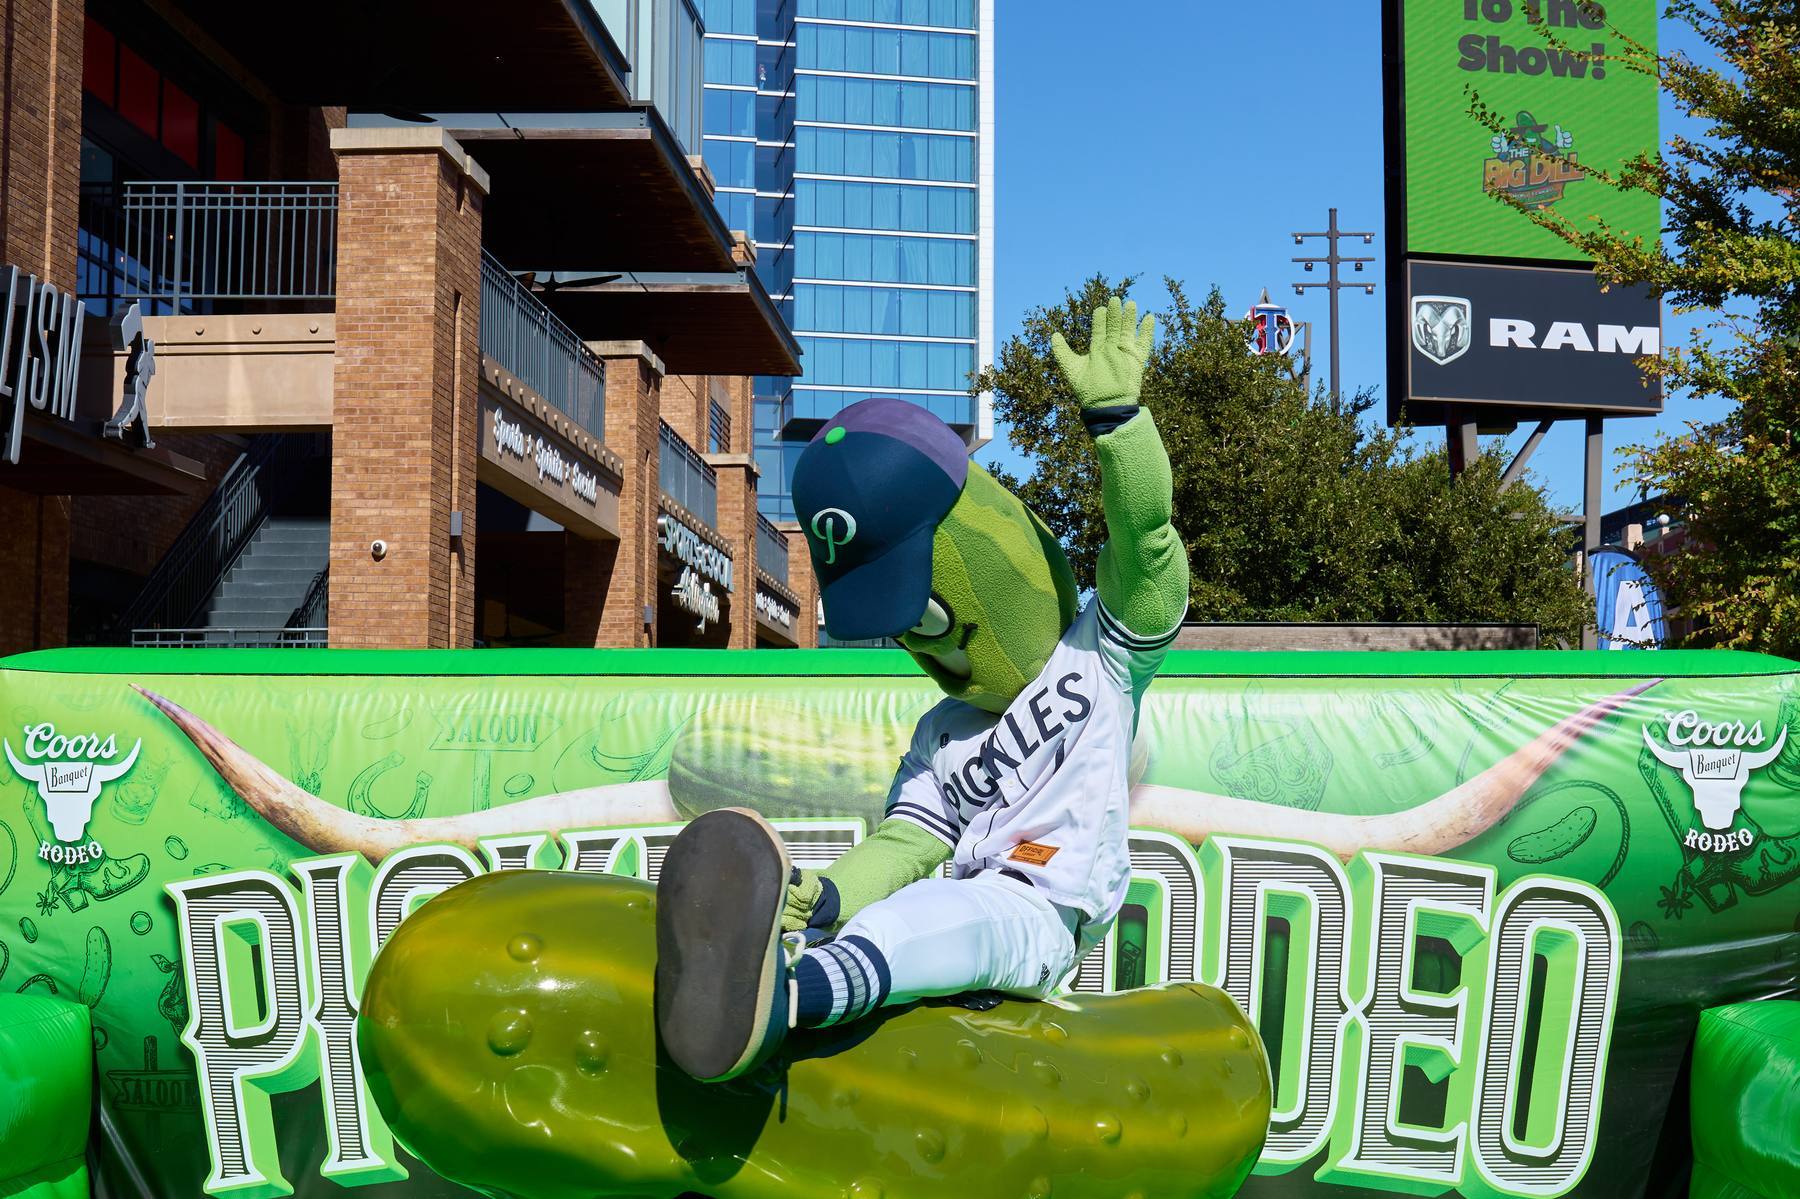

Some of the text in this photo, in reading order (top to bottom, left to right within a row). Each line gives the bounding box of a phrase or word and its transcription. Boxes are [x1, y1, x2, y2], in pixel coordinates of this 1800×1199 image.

[1457, 34, 1607, 80] Show!
[1484, 152, 1585, 190] BIG DILL
[1509, 147, 1530, 159] THE
[1489, 317, 1660, 355] RAM
[493, 407, 524, 456] Sports
[572, 462, 597, 503] Social
[811, 507, 857, 565] P
[1609, 581, 1658, 650] A
[24, 722, 118, 759] Coors
[446, 713, 538, 743] SALOON
[942, 671, 1091, 810] PICKLES
[1664, 709, 1766, 746] Coors
[51, 765, 88, 788] Banquet
[1697, 752, 1736, 775] Banquet
[38, 840, 103, 865] RODEO
[1684, 828, 1754, 853] RODEO
[1040, 827, 1622, 1199] DEO
